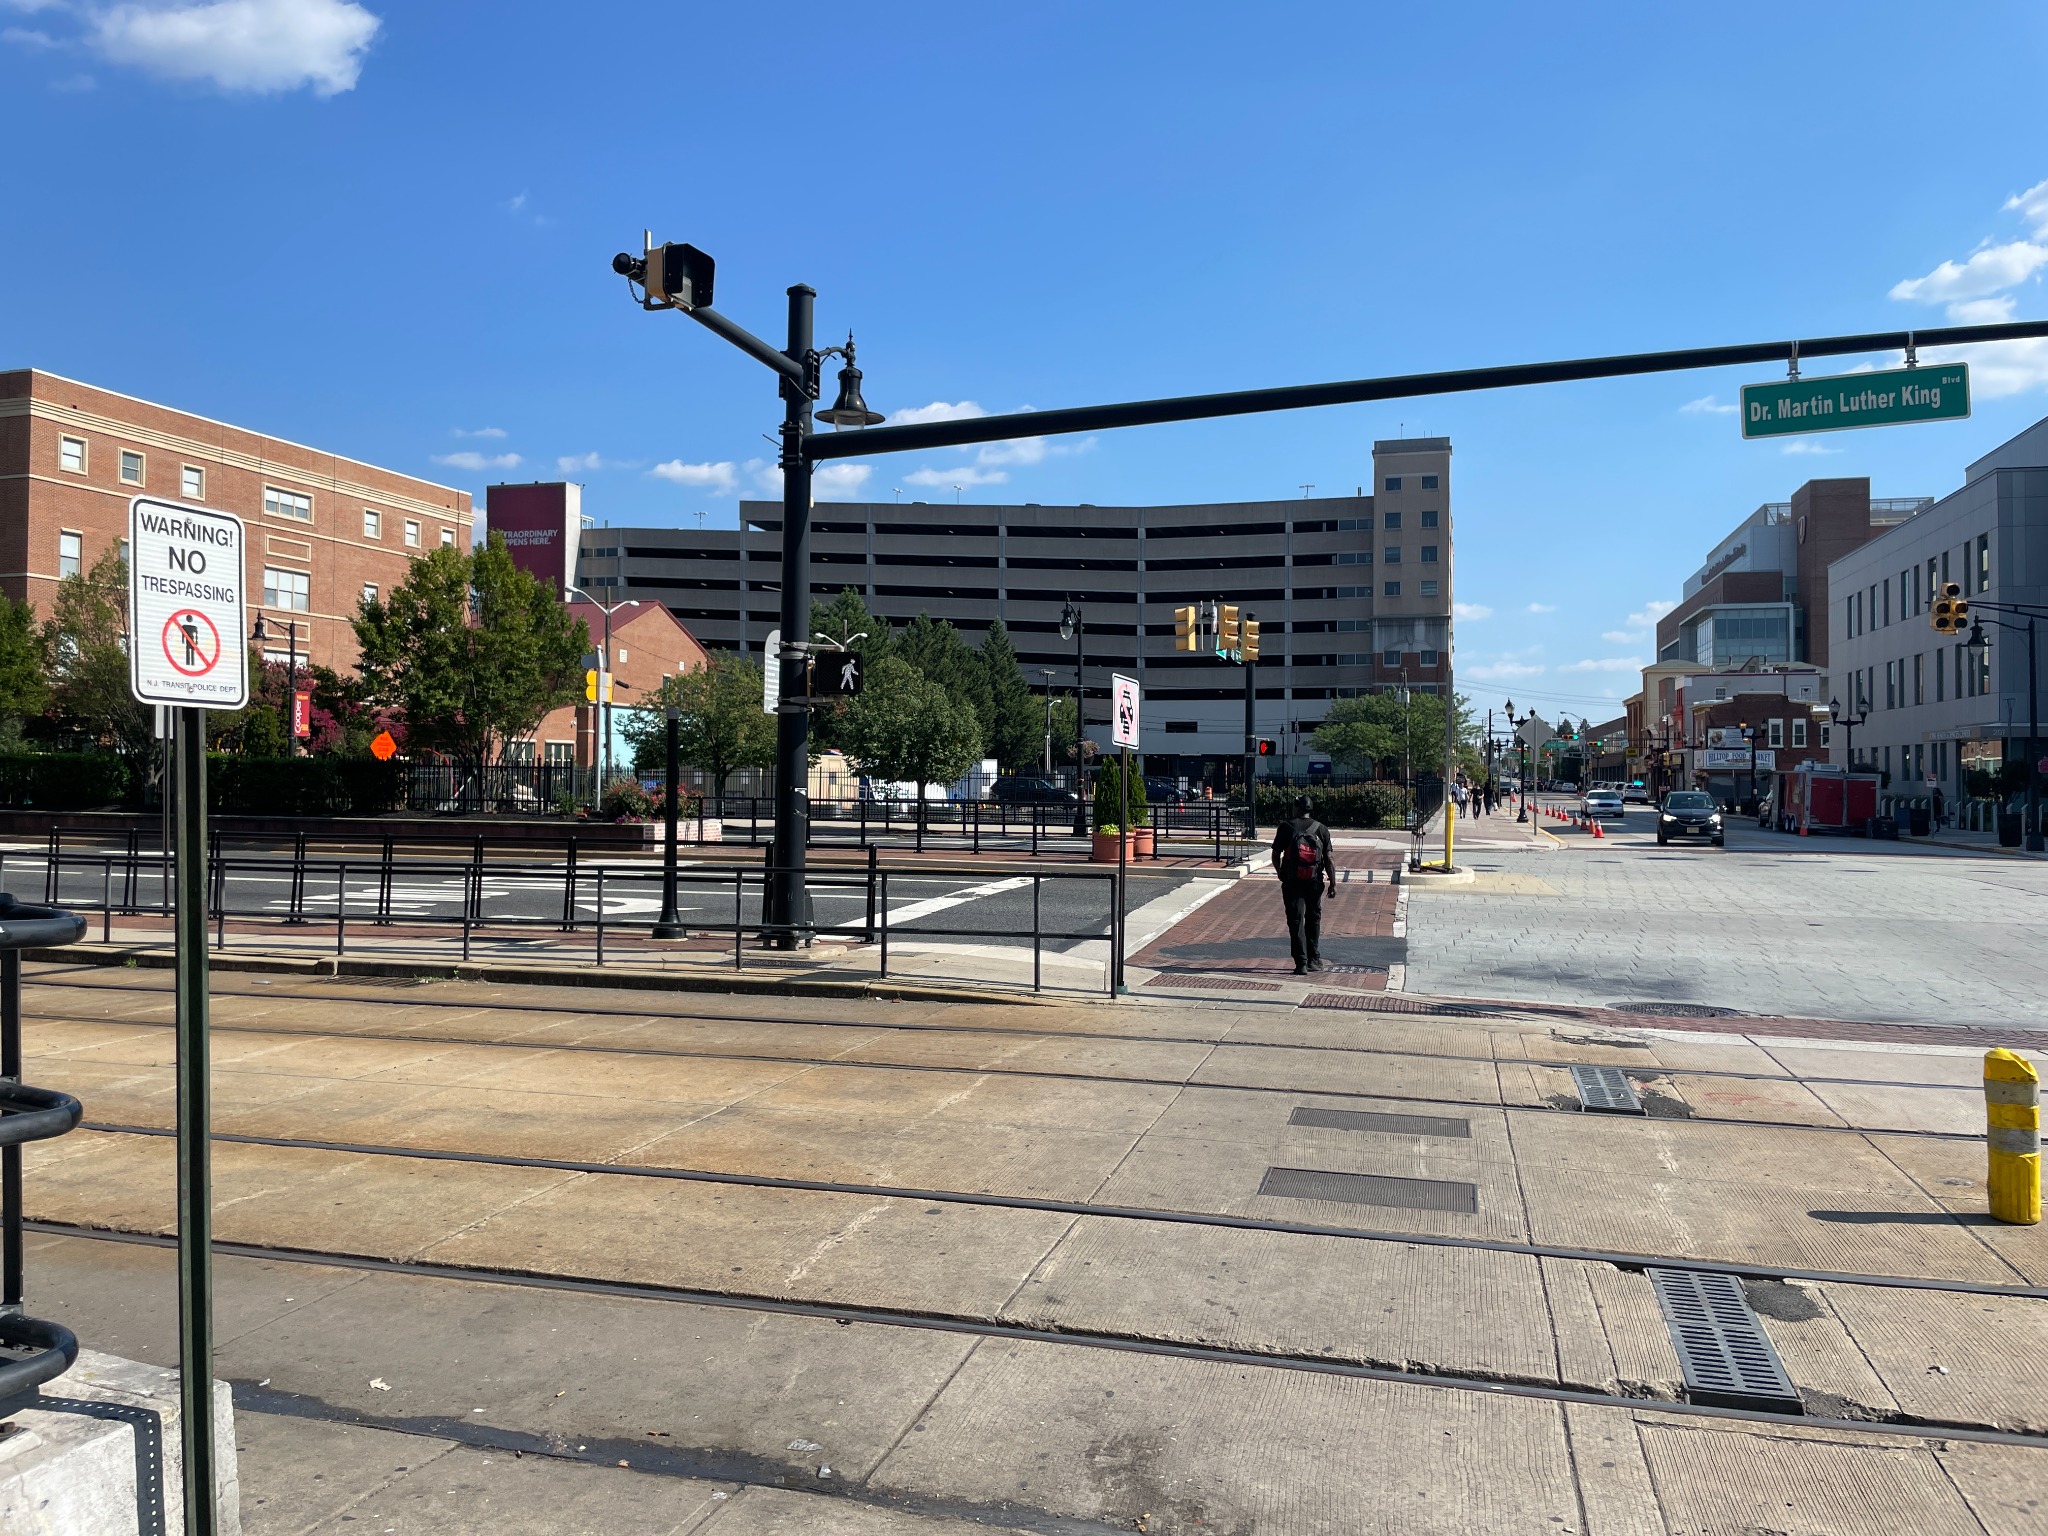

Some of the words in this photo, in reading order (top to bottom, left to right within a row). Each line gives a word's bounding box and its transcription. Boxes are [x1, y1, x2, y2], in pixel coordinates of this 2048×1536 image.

[1750, 401, 1772, 422] Dr.
[1778, 394, 1834, 419] Martin
[1840, 389, 1896, 412] Luther
[1902, 384, 1941, 408] King
[1942, 375, 1961, 385] Blvd
[140, 512, 233, 548] WARNING!
[502, 529, 558, 538] TRAORDINARY
[529, 537, 551, 545] HERE.
[168, 546, 207, 575] NO
[141, 574, 235, 604] TRESPASSING
[162, 680, 190, 690] TRANSIT
[192, 683, 217, 692] POLICE
[219, 685, 239, 694] DEPT.
[295, 700, 303, 734] Cooper
[1708, 752, 1730, 763] HILLTOP
[1732, 752, 1747, 760] FOOD
